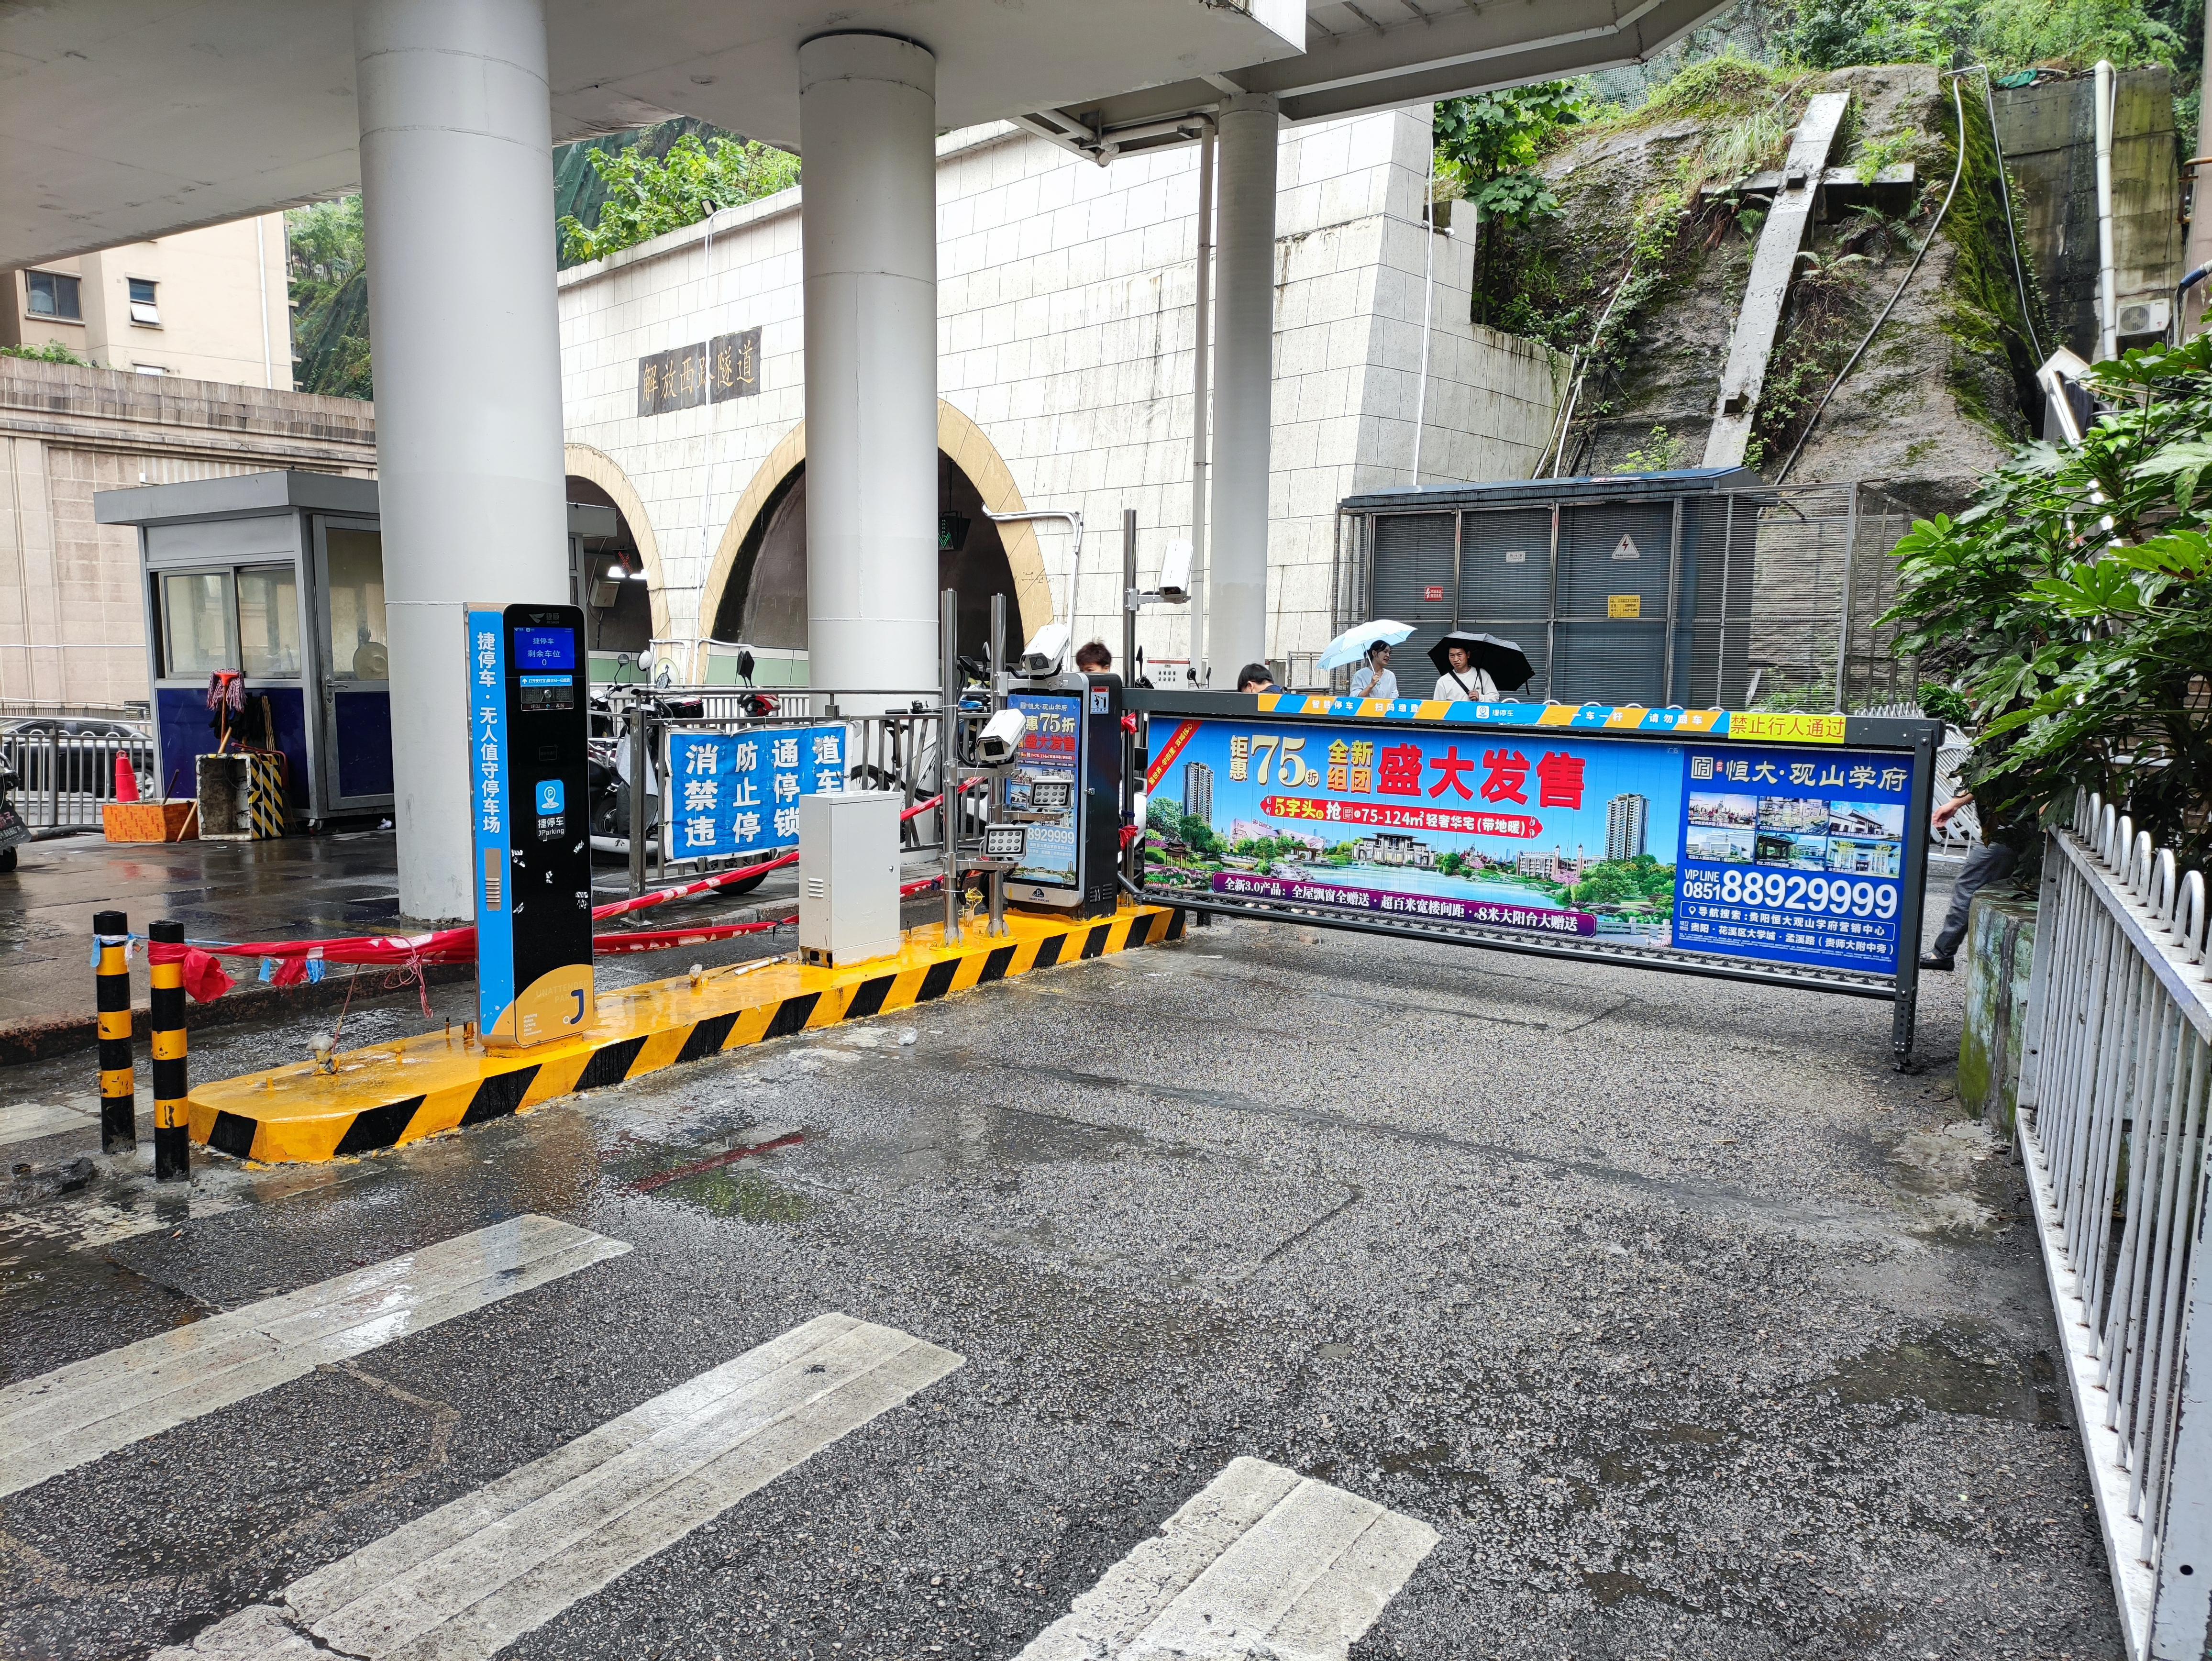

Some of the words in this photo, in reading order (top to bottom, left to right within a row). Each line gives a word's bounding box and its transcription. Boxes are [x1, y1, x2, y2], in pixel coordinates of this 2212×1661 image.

[527, 650, 561, 658] 剩余车位
[1311, 699, 1354, 710] 智慧停车
[1374, 702, 1419, 714] 扫码缴费
[1572, 710, 1623, 722] 一车一杆
[1648, 713, 1703, 725] 请勿跟车
[1730, 715, 1845, 738] 禁止行人通过
[686, 735, 842, 775] 消防通道
[1025, 733, 1075, 752] 盛大发售
[1327, 738, 1374, 766] 全新
[1229, 735, 1249, 781] 钜惠
[1251, 734, 1306, 788] 75
[1307, 771, 1317, 784] 折
[1327, 766, 1371, 795] 组团
[1377, 742, 1586, 810] 盛大发售
[1725, 759, 1908, 792] 恒大·观山学府
[684, 769, 842, 812] 禁止停车
[1274, 797, 1316, 819] 5字头
[1326, 801, 1341, 820] 抢
[538, 816, 564, 829] 捷停车
[538, 828, 564, 837] JParking
[1684, 869, 1699, 880] VIP
[1699, 870, 1720, 883] LINE
[1683, 881, 1721, 900] 0851
[1721, 870, 1898, 919] 88929999
[536, 980, 589, 997] UNATTENDED
